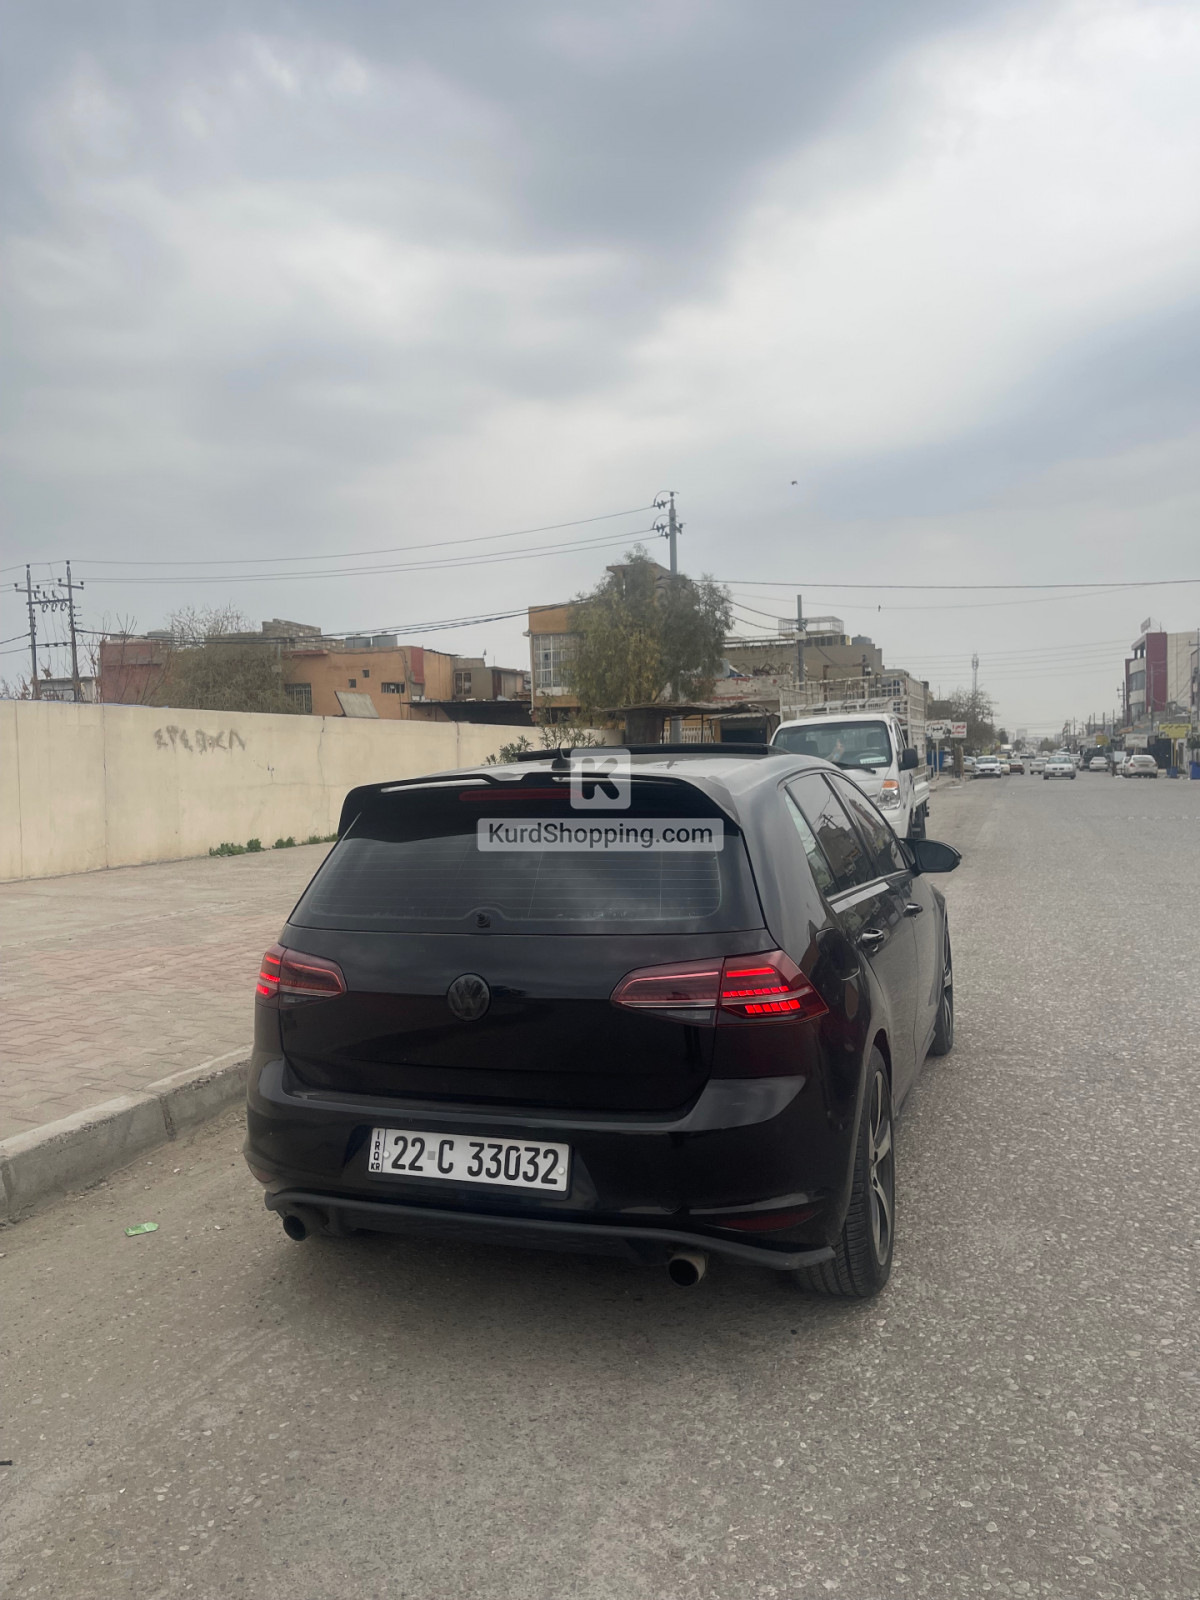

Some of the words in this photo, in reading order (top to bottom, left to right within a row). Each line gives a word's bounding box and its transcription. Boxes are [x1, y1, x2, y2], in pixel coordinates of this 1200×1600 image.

[371, 1162, 380, 1171] KR
[391, 1136, 425, 1172] 22
[437, 1139, 454, 1174] C
[467, 1142, 559, 1185] 33032
